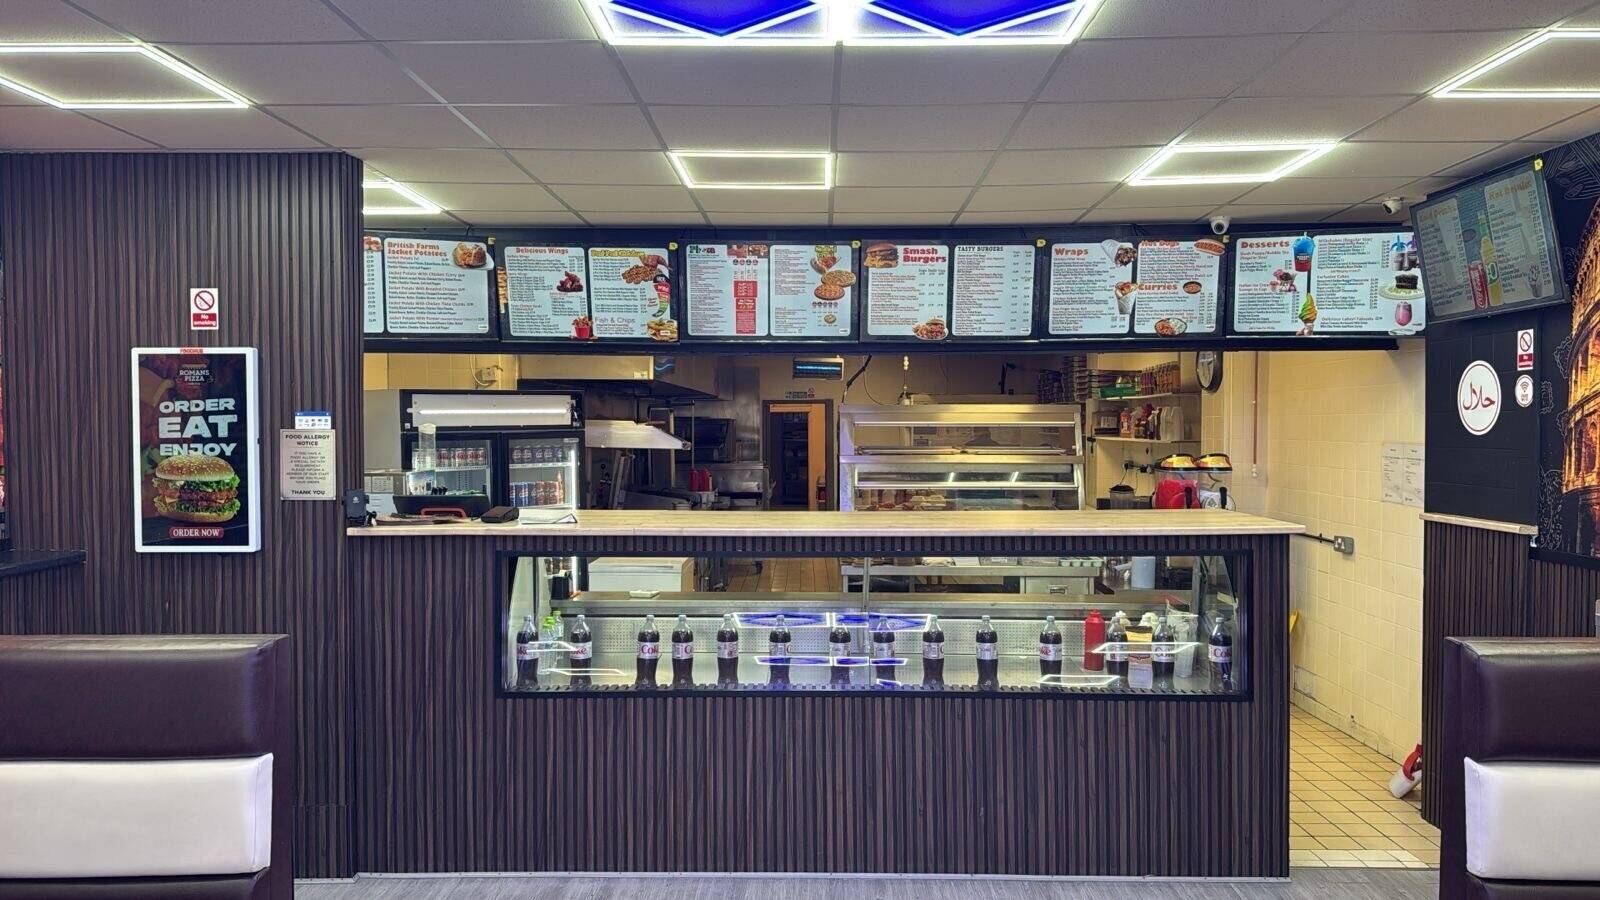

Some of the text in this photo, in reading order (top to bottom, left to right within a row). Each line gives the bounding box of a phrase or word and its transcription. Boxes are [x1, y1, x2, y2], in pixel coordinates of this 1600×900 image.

[1241, 240, 1290, 249] Desserts
[903, 247, 938, 255] Smash
[1055, 248, 1089, 256] Wraps
[903, 255, 947, 264] Burgers
[1138, 283, 1178, 291] Curries
[1463, 381, 1496, 411] حلال
[159, 398, 235, 414] ORDER
[158, 414, 238, 439] EAT
[159, 442, 238, 457] ENJOY
[173, 528, 220, 537] ORDER NOW
